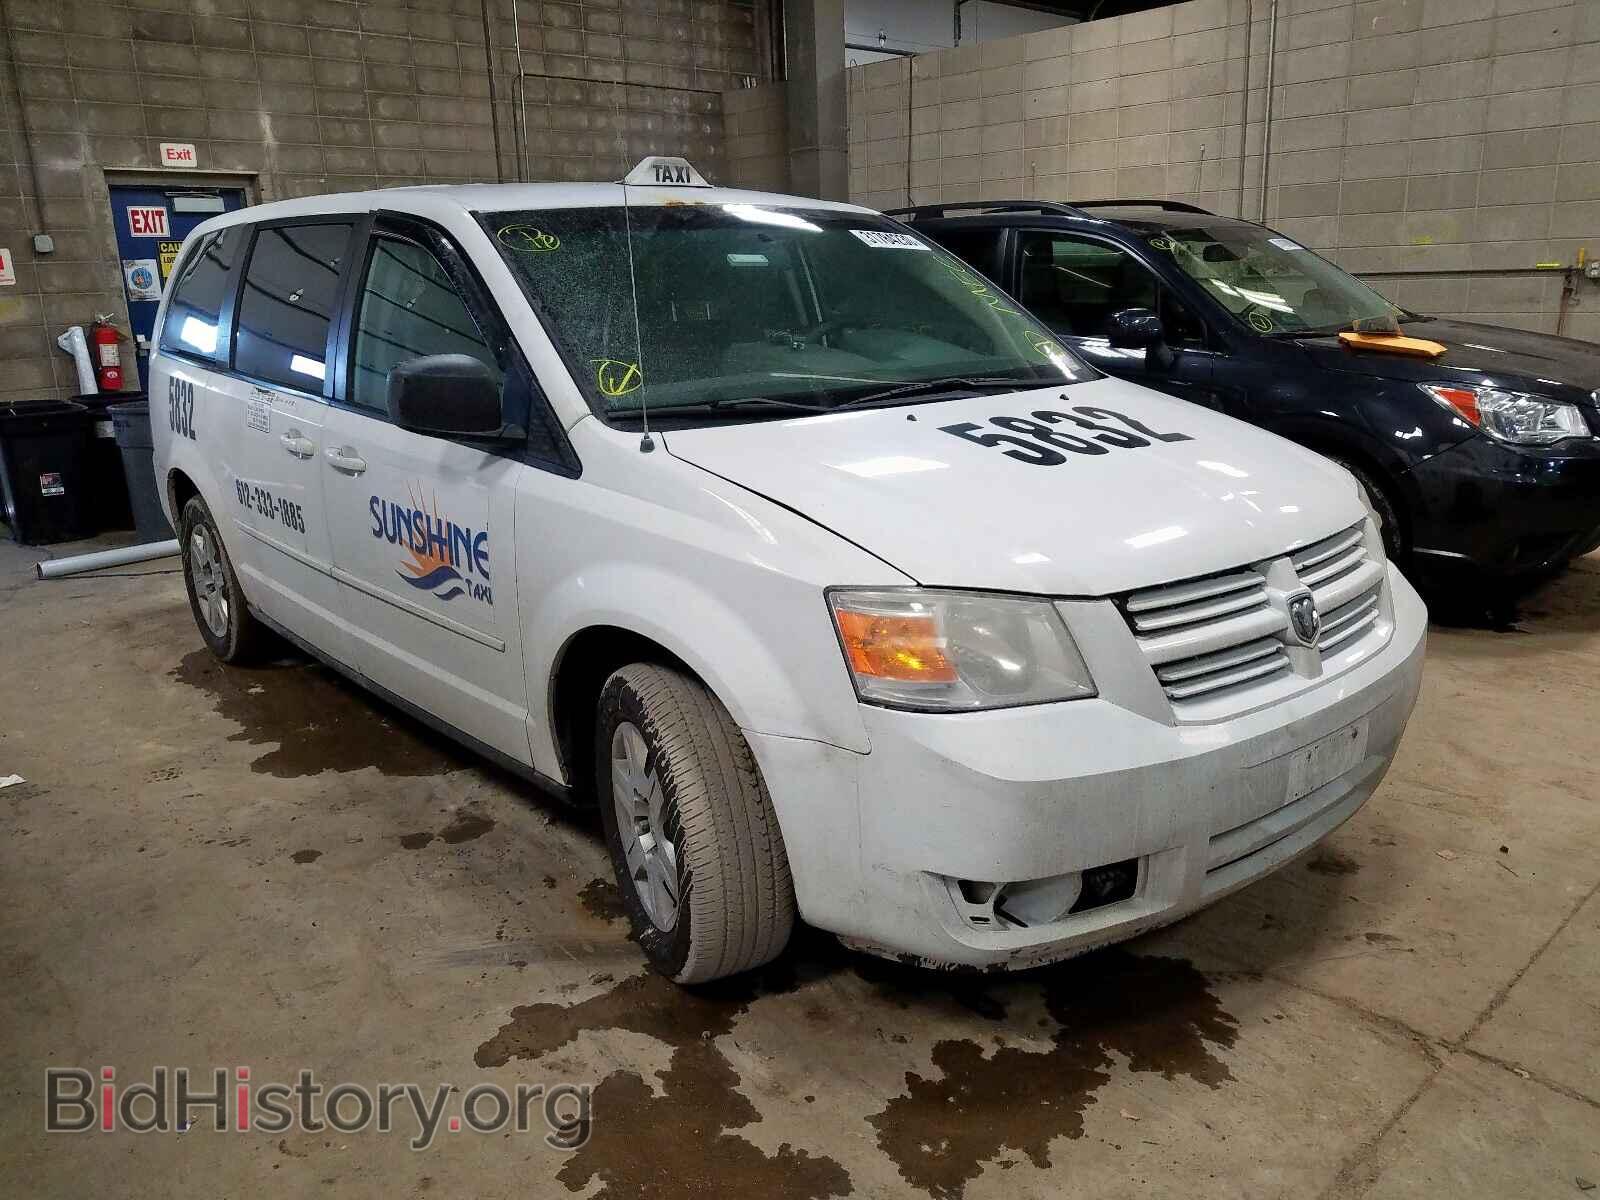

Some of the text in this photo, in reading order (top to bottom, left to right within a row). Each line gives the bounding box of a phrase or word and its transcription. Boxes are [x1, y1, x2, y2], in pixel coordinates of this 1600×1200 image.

[166, 148, 192, 160] Exit
[652, 164, 690, 183] TAXI
[130, 209, 164, 234] EXIT
[168, 375, 197, 440] 5832
[936, 406, 1196, 466] 5832
[235, 478, 306, 534] 612-333-1885
[369, 495, 490, 581] SUNSHINE
[465, 578, 494, 605] TAXI
